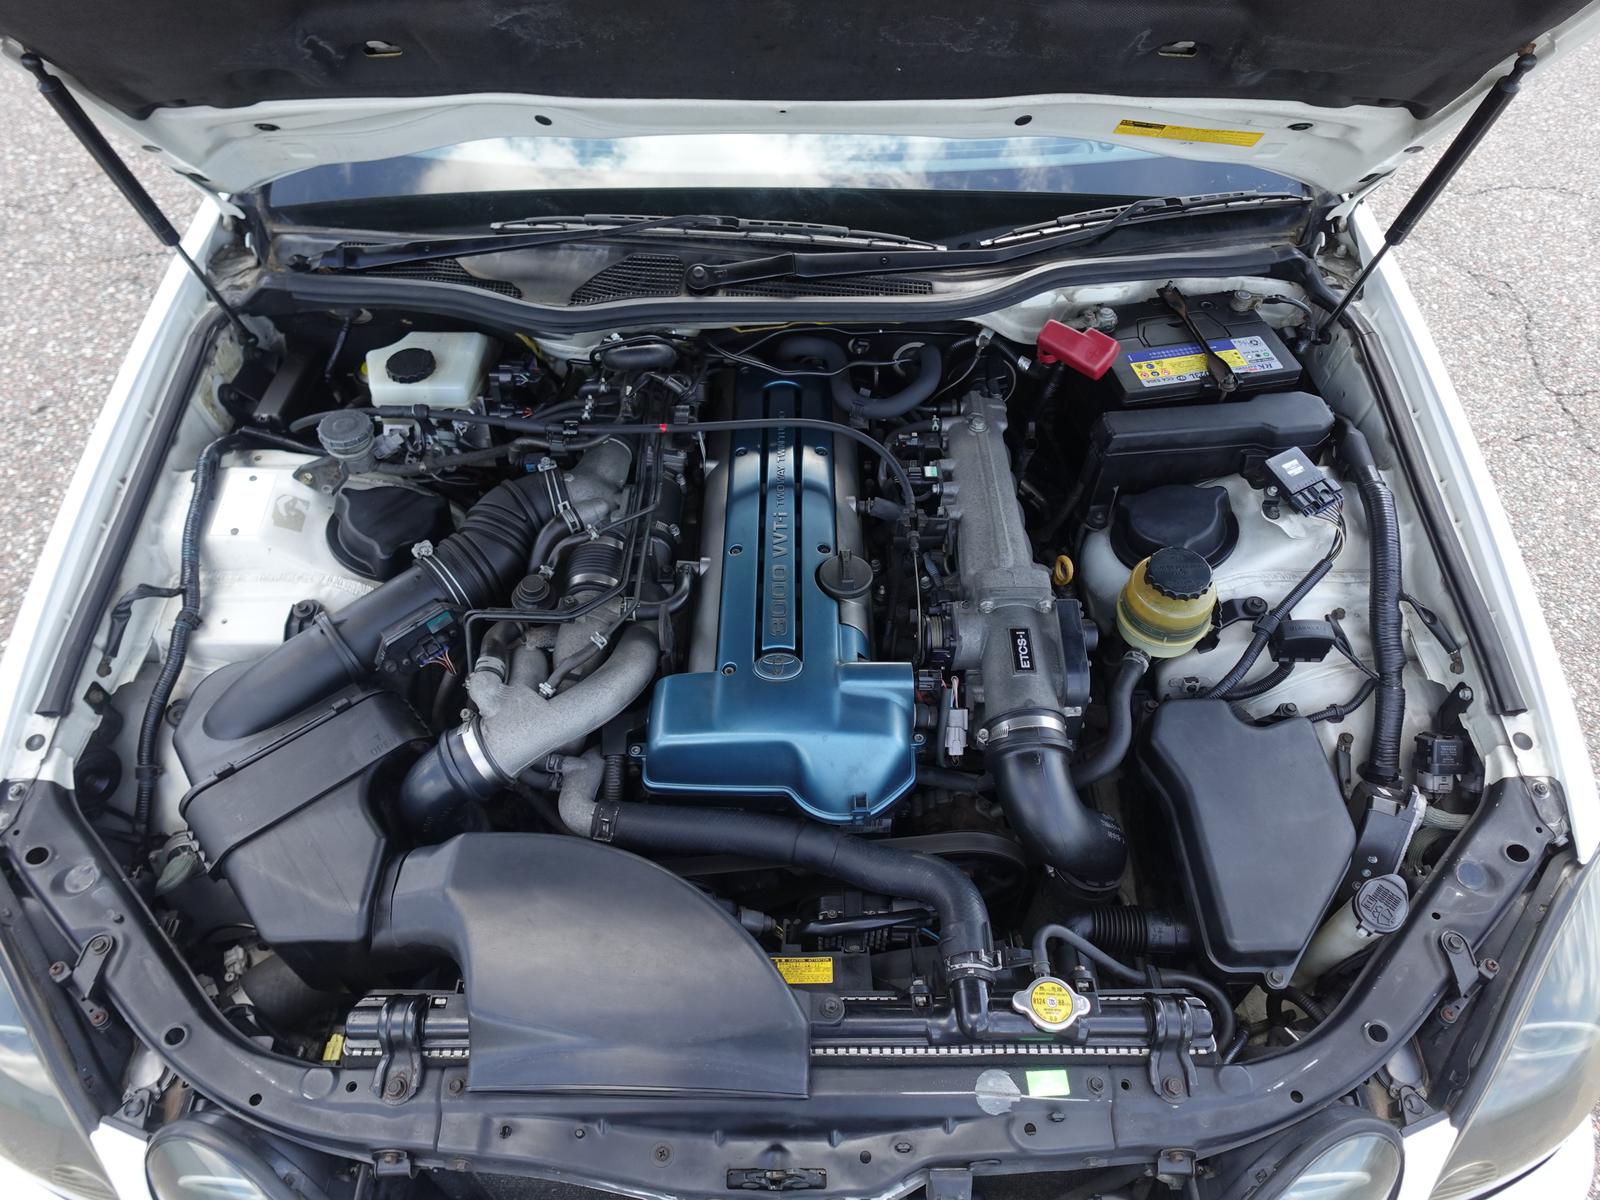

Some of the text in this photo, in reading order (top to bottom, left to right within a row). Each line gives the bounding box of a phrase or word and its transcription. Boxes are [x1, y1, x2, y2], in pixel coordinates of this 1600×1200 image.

[772, 511, 788, 559] VVT-i
[769, 564, 788, 638] 3000
[1016, 631, 1031, 669] ETCS-I
